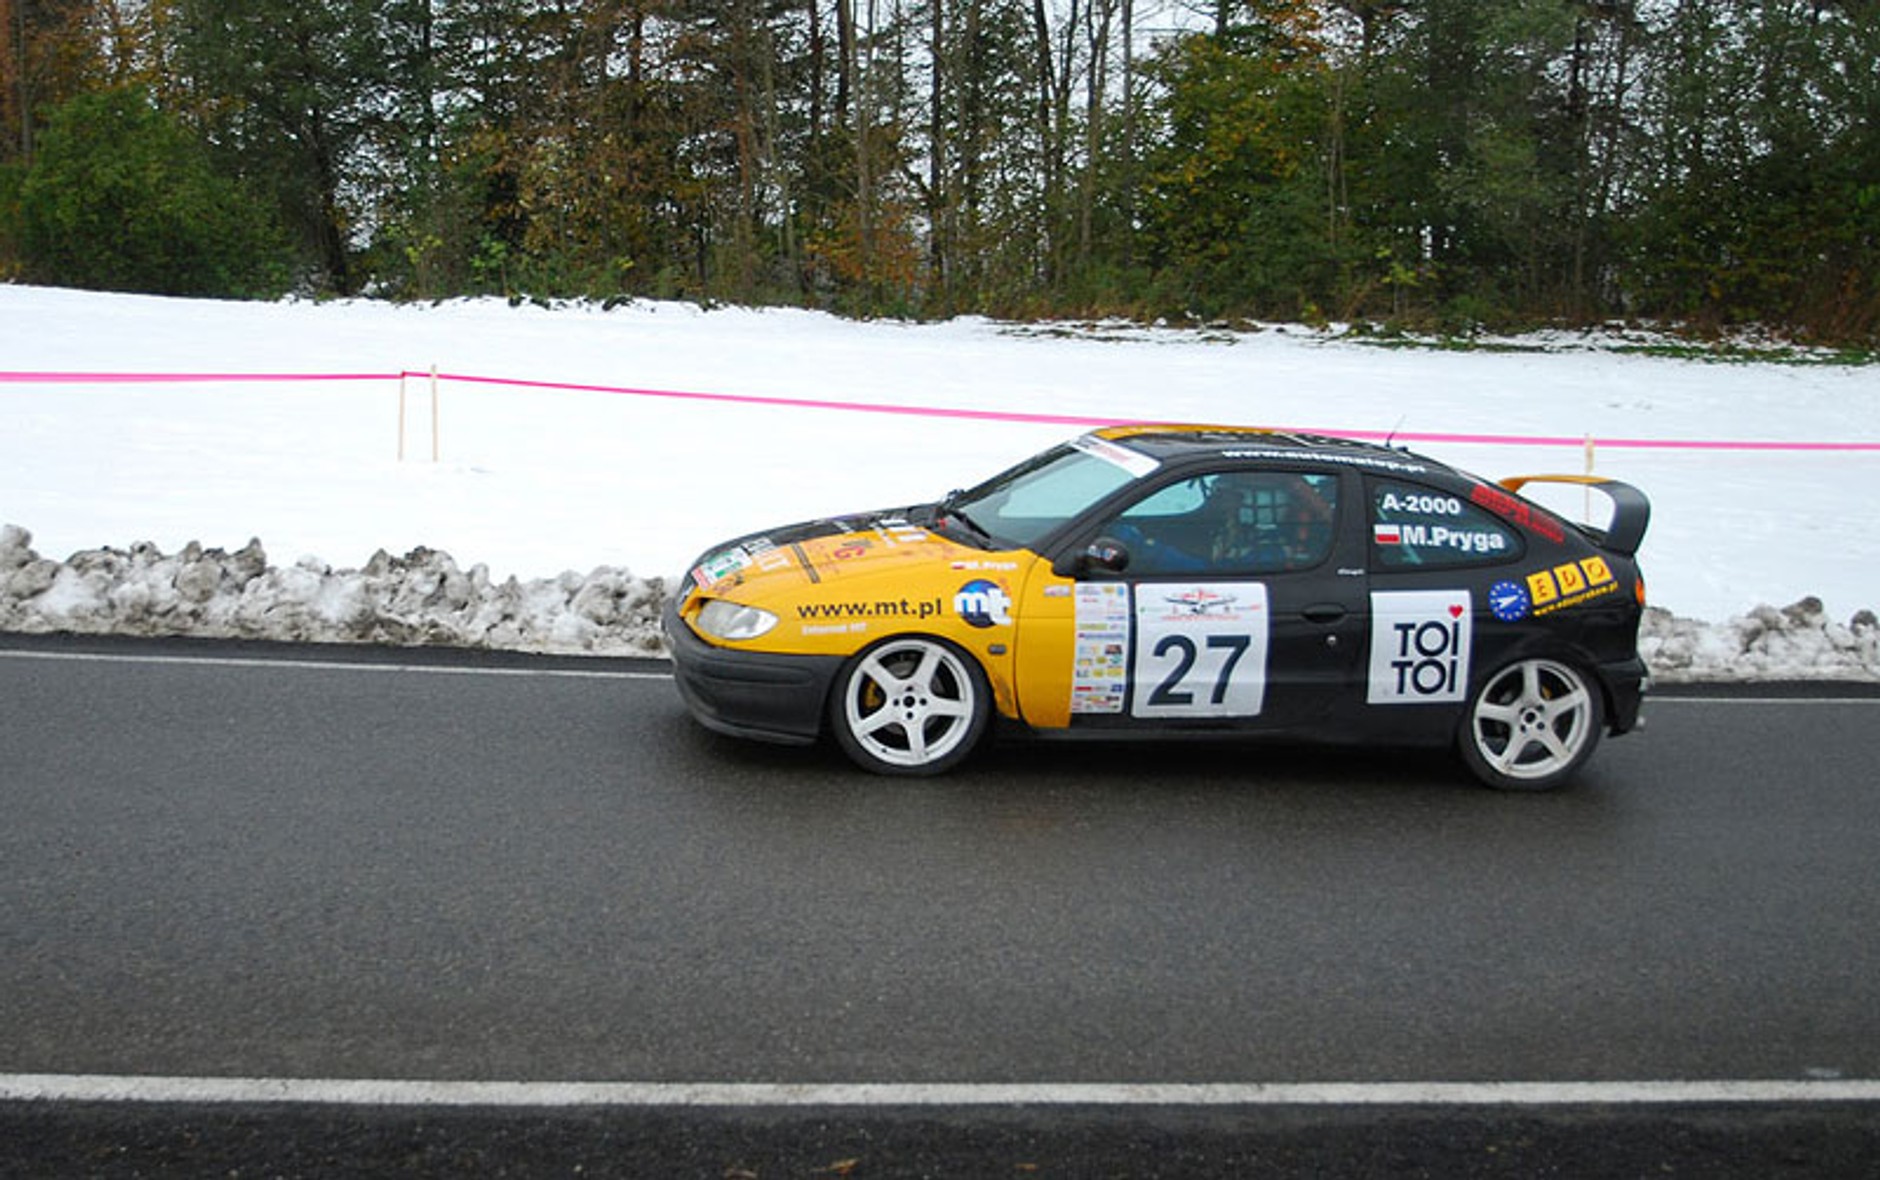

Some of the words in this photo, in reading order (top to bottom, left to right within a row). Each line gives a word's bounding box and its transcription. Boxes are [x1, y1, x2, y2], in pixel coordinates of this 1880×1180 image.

[1382, 493, 1461, 515] A-2000
[1402, 525, 1505, 552] M.Pryga
[1534, 558, 1608, 600] EDO
[797, 598, 942, 620] www.mt.pl
[953, 586, 1012, 626] mt
[1394, 620, 1459, 657] TOI
[1147, 634, 1251, 706] 27
[1391, 658, 1457, 695] TOI
